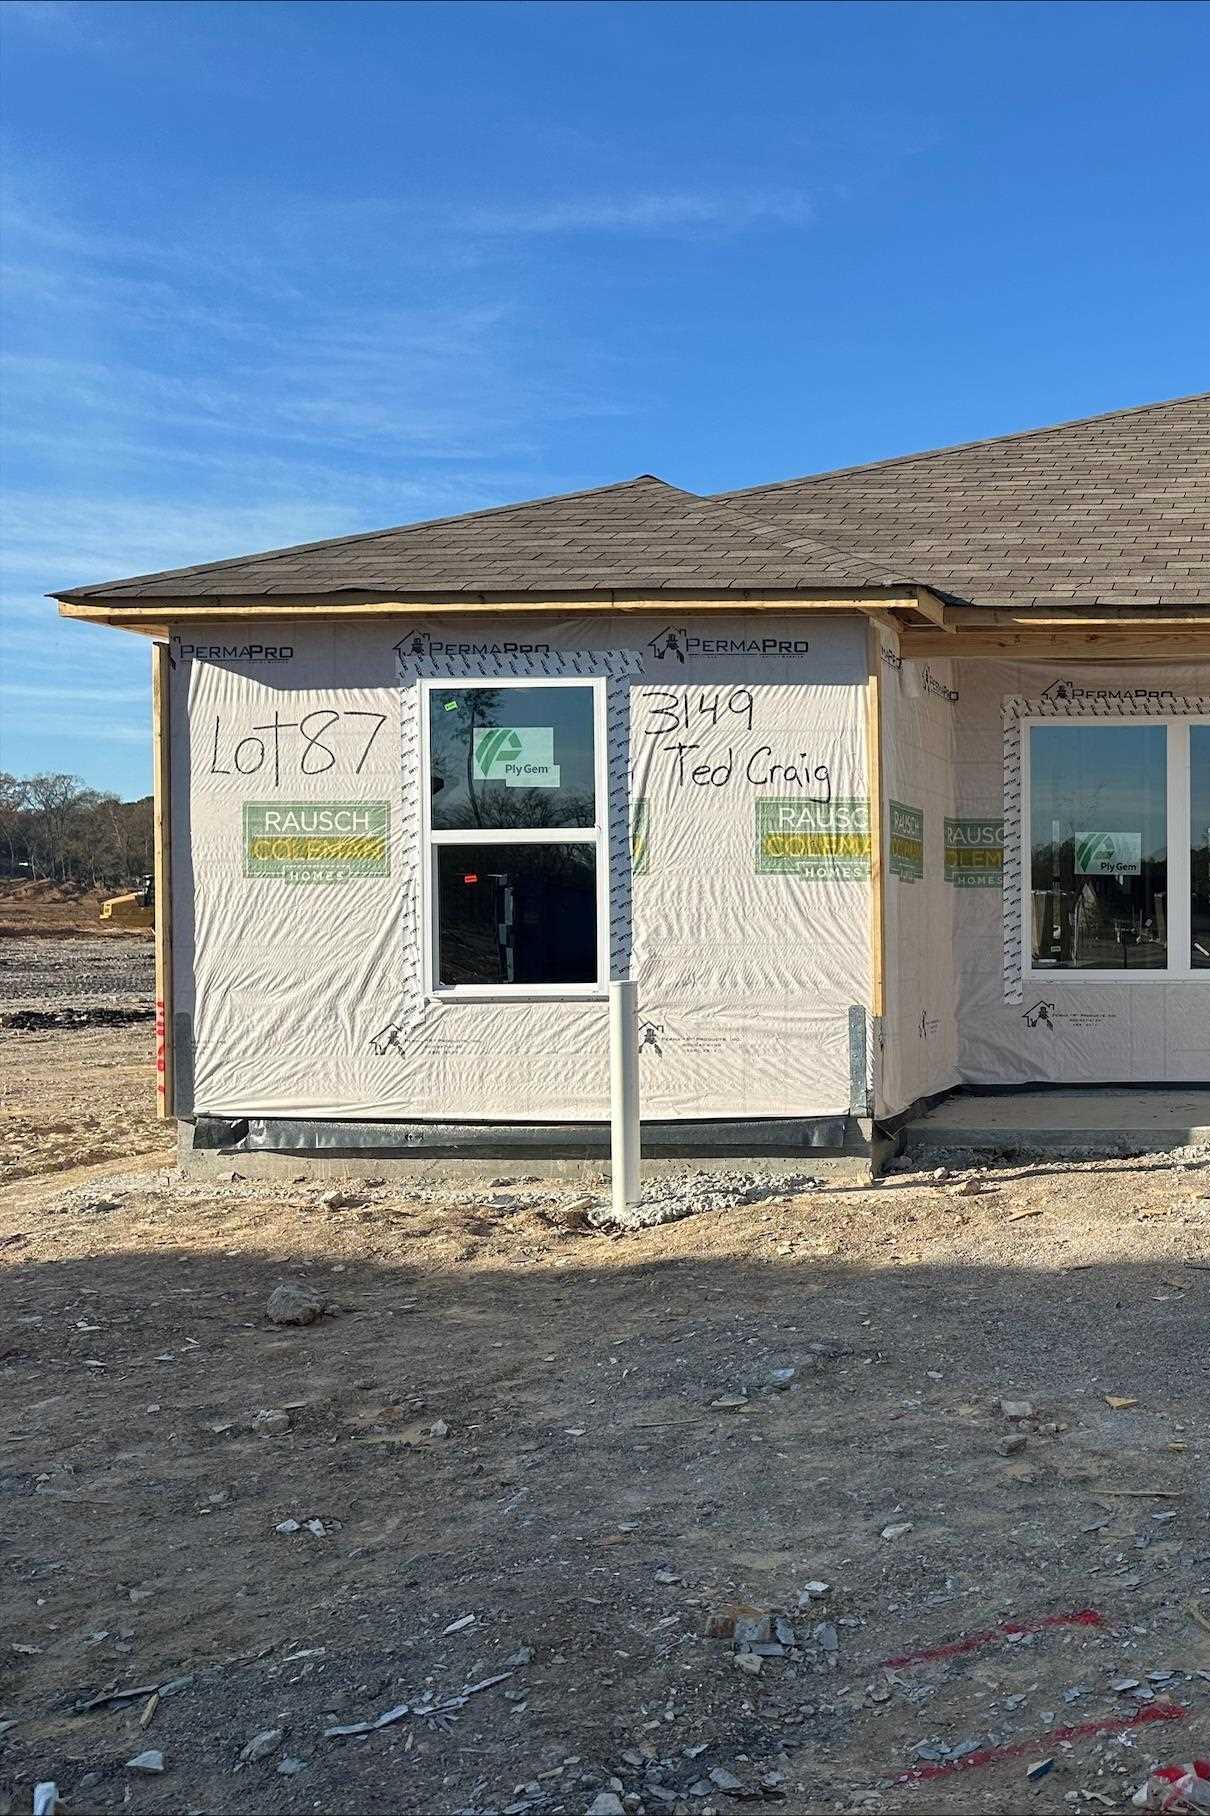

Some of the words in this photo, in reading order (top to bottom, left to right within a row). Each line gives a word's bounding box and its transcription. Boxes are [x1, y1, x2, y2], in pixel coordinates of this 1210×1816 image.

[643, 690, 754, 735] 3149
[300, 709, 387, 775] 87
[664, 742, 733, 787] Ted
[746, 746, 831, 804] Craig
[265, 810, 369, 832] RAUSCH
[805, 867, 861, 878] HOMES
